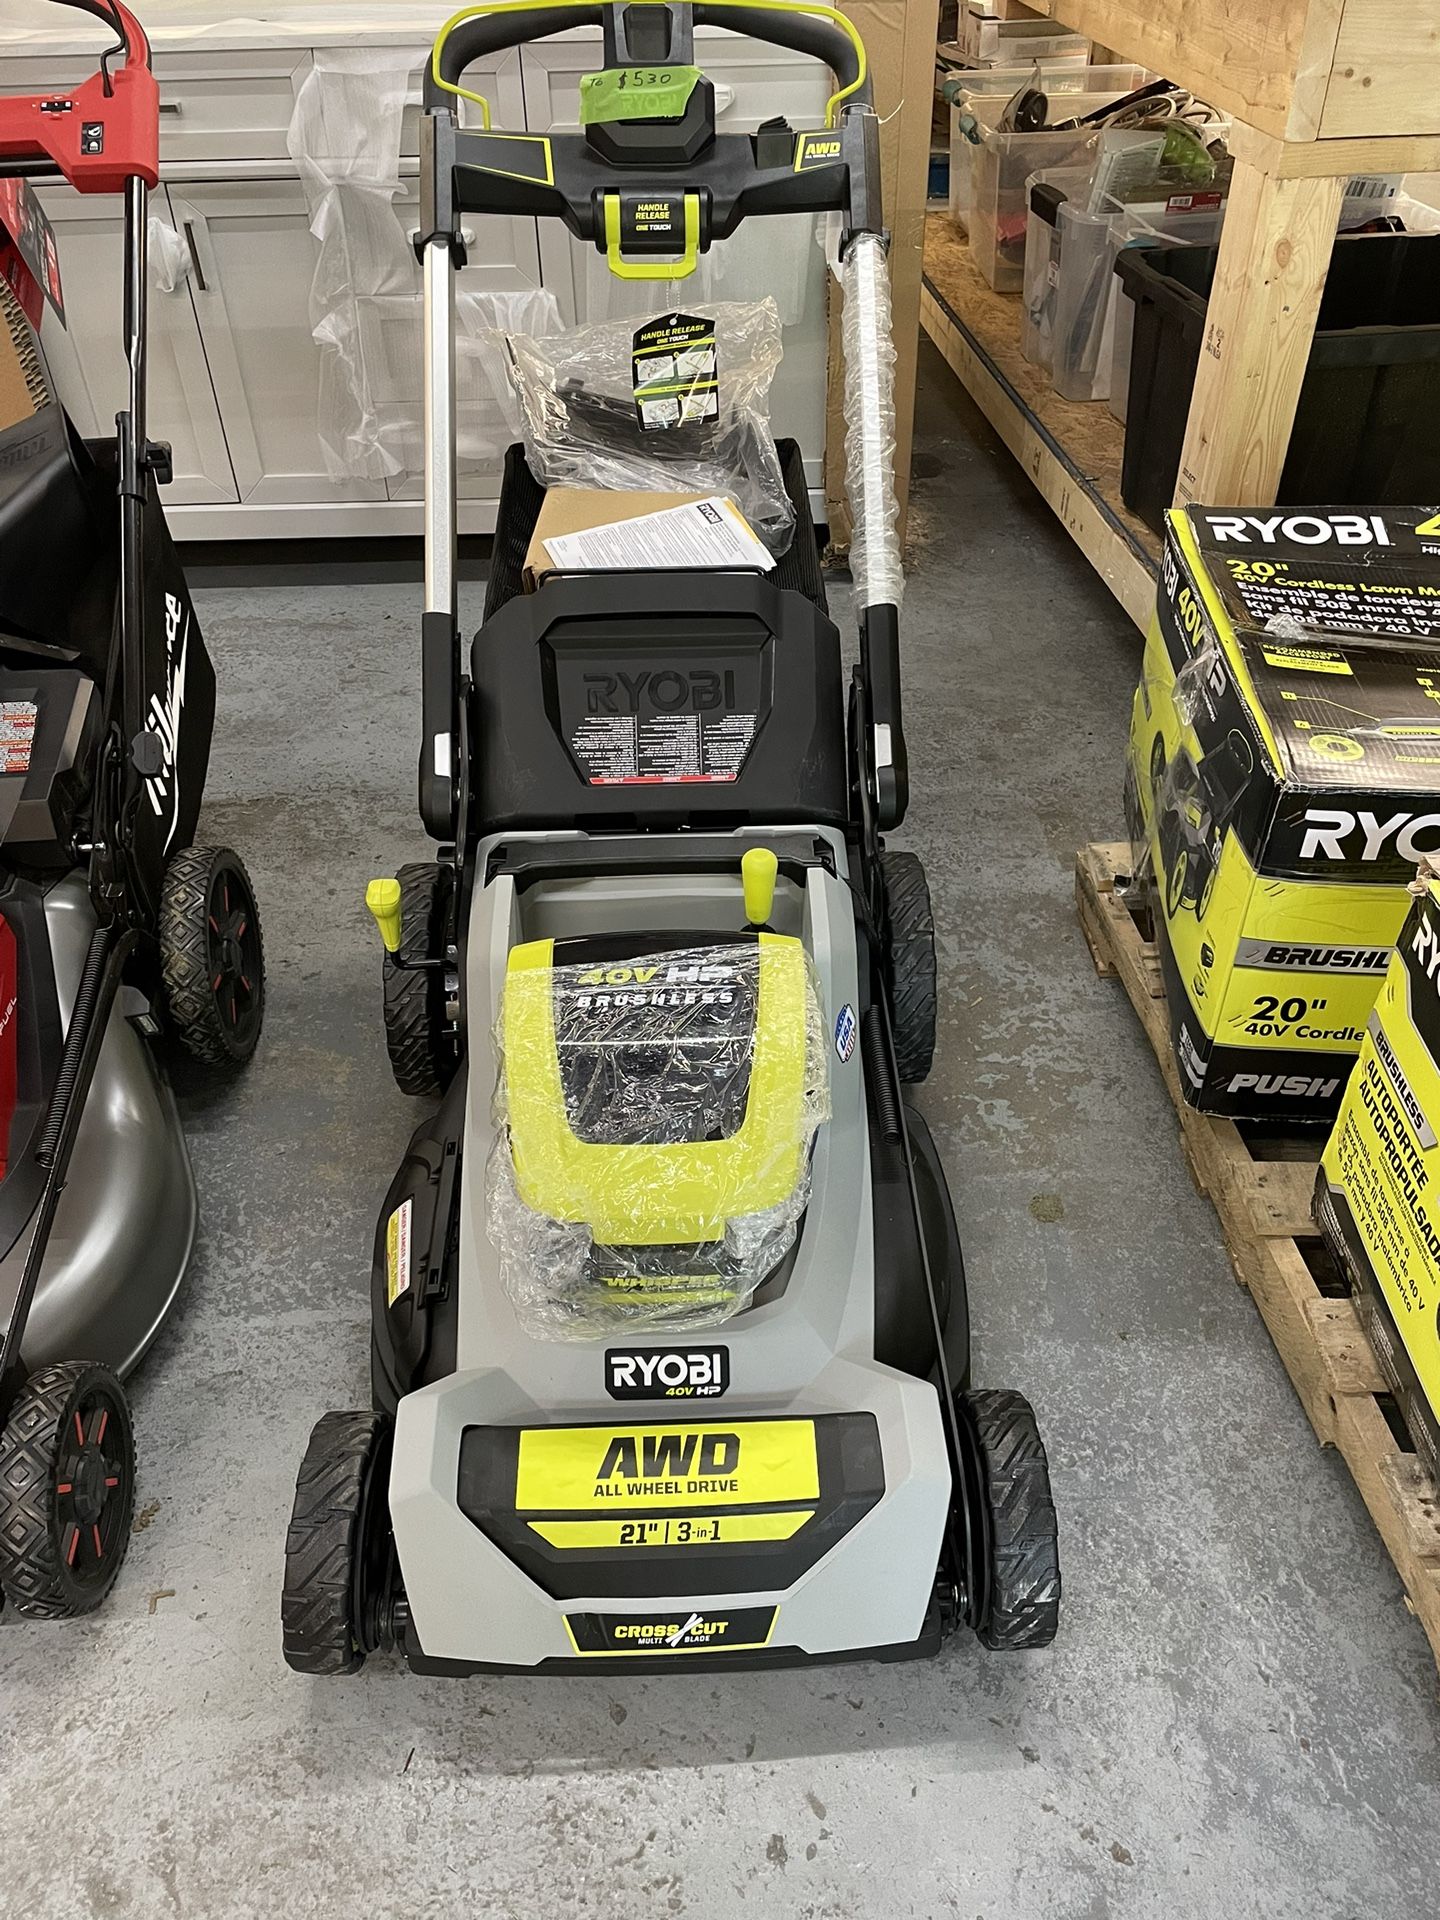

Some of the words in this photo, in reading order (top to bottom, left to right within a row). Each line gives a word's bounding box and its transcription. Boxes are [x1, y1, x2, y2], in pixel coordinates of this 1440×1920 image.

[618, 70, 671, 90] $530
[805, 141, 841, 155] AWD
[635, 211, 670, 220] RELEASE
[637, 203, 669, 212] HANDLE
[635, 224, 649, 232] ONE
[649, 223, 672, 231] TOUCH
[640, 329, 671, 341] HANDLE
[671, 324, 706, 335] RELEASE
[669, 334, 689, 343] TOUCH
[1205, 516, 1390, 546] RYOBI
[1226, 560, 1289, 577] 20"
[1232, 573, 1269, 584] 40V
[1274, 577, 1356, 592] Cordless
[1359, 583, 1414, 595] Lawn
[1418, 586, 1440, 597] M
[1236, 581, 1330, 600] Ensemble
[1334, 592, 1360, 602] de
[1240, 591, 1286, 604] sans
[1292, 596, 1310, 607] fil
[1314, 599, 1352, 611] 508
[1357, 604, 1397, 614] mm
[1401, 606, 1427, 616] de
[1245, 600, 1273, 611] Kit
[1278, 605, 1304, 615] de
[1308, 609, 1408, 625] podadora
[1324, 619, 1364, 630] mm
[1367, 624, 1380, 633] y
[1385, 624, 1412, 634] 40
[1414, 625, 1431, 636] V
[583, 670, 736, 713] RYOBI
[578, 966, 662, 985] 40V
[665, 966, 734, 983] HP
[577, 991, 734, 1009] BRUSHLESS
[1249, 996, 1327, 1023] 20"
[1244, 1022, 1291, 1038] 40V
[1226, 1073, 1341, 1098] PUSH
[1376, 1030, 1425, 1130] BRUSHLESS
[1367, 1059, 1429, 1191] AUTOPORTÉE
[1352, 1171, 1378, 1231] podadora
[1350, 1188, 1362, 1213] mm
[1365, 1223, 1374, 1240] 40
[1373, 1239, 1380, 1252] V
[1380, 1185, 1405, 1246] tondeuse
[1358, 1159, 1371, 1189] sans
[1376, 1202, 1389, 1230] 508
[1388, 1230, 1400, 1258] mm
[1399, 1259, 1409, 1278] de
[1408, 1279, 1419, 1298] 40
[1419, 1297, 1426, 1310] V
[611, 1353, 721, 1387] RYOBI
[665, 1387, 694, 1396] 40V
[696, 1386, 721, 1395] HP
[596, 1433, 741, 1480] AWD
[593, 1484, 622, 1497] ALL
[627, 1481, 682, 1495] WHEEL
[687, 1479, 739, 1493] DRIVE
[620, 1523, 658, 1545] 21"
[677, 1520, 721, 1542] 3-in-1
[614, 1624, 680, 1638] CROSS
[690, 1622, 729, 1636] CUT
[638, 1637, 663, 1645] MULTI
[684, 1635, 711, 1643] BLADE
